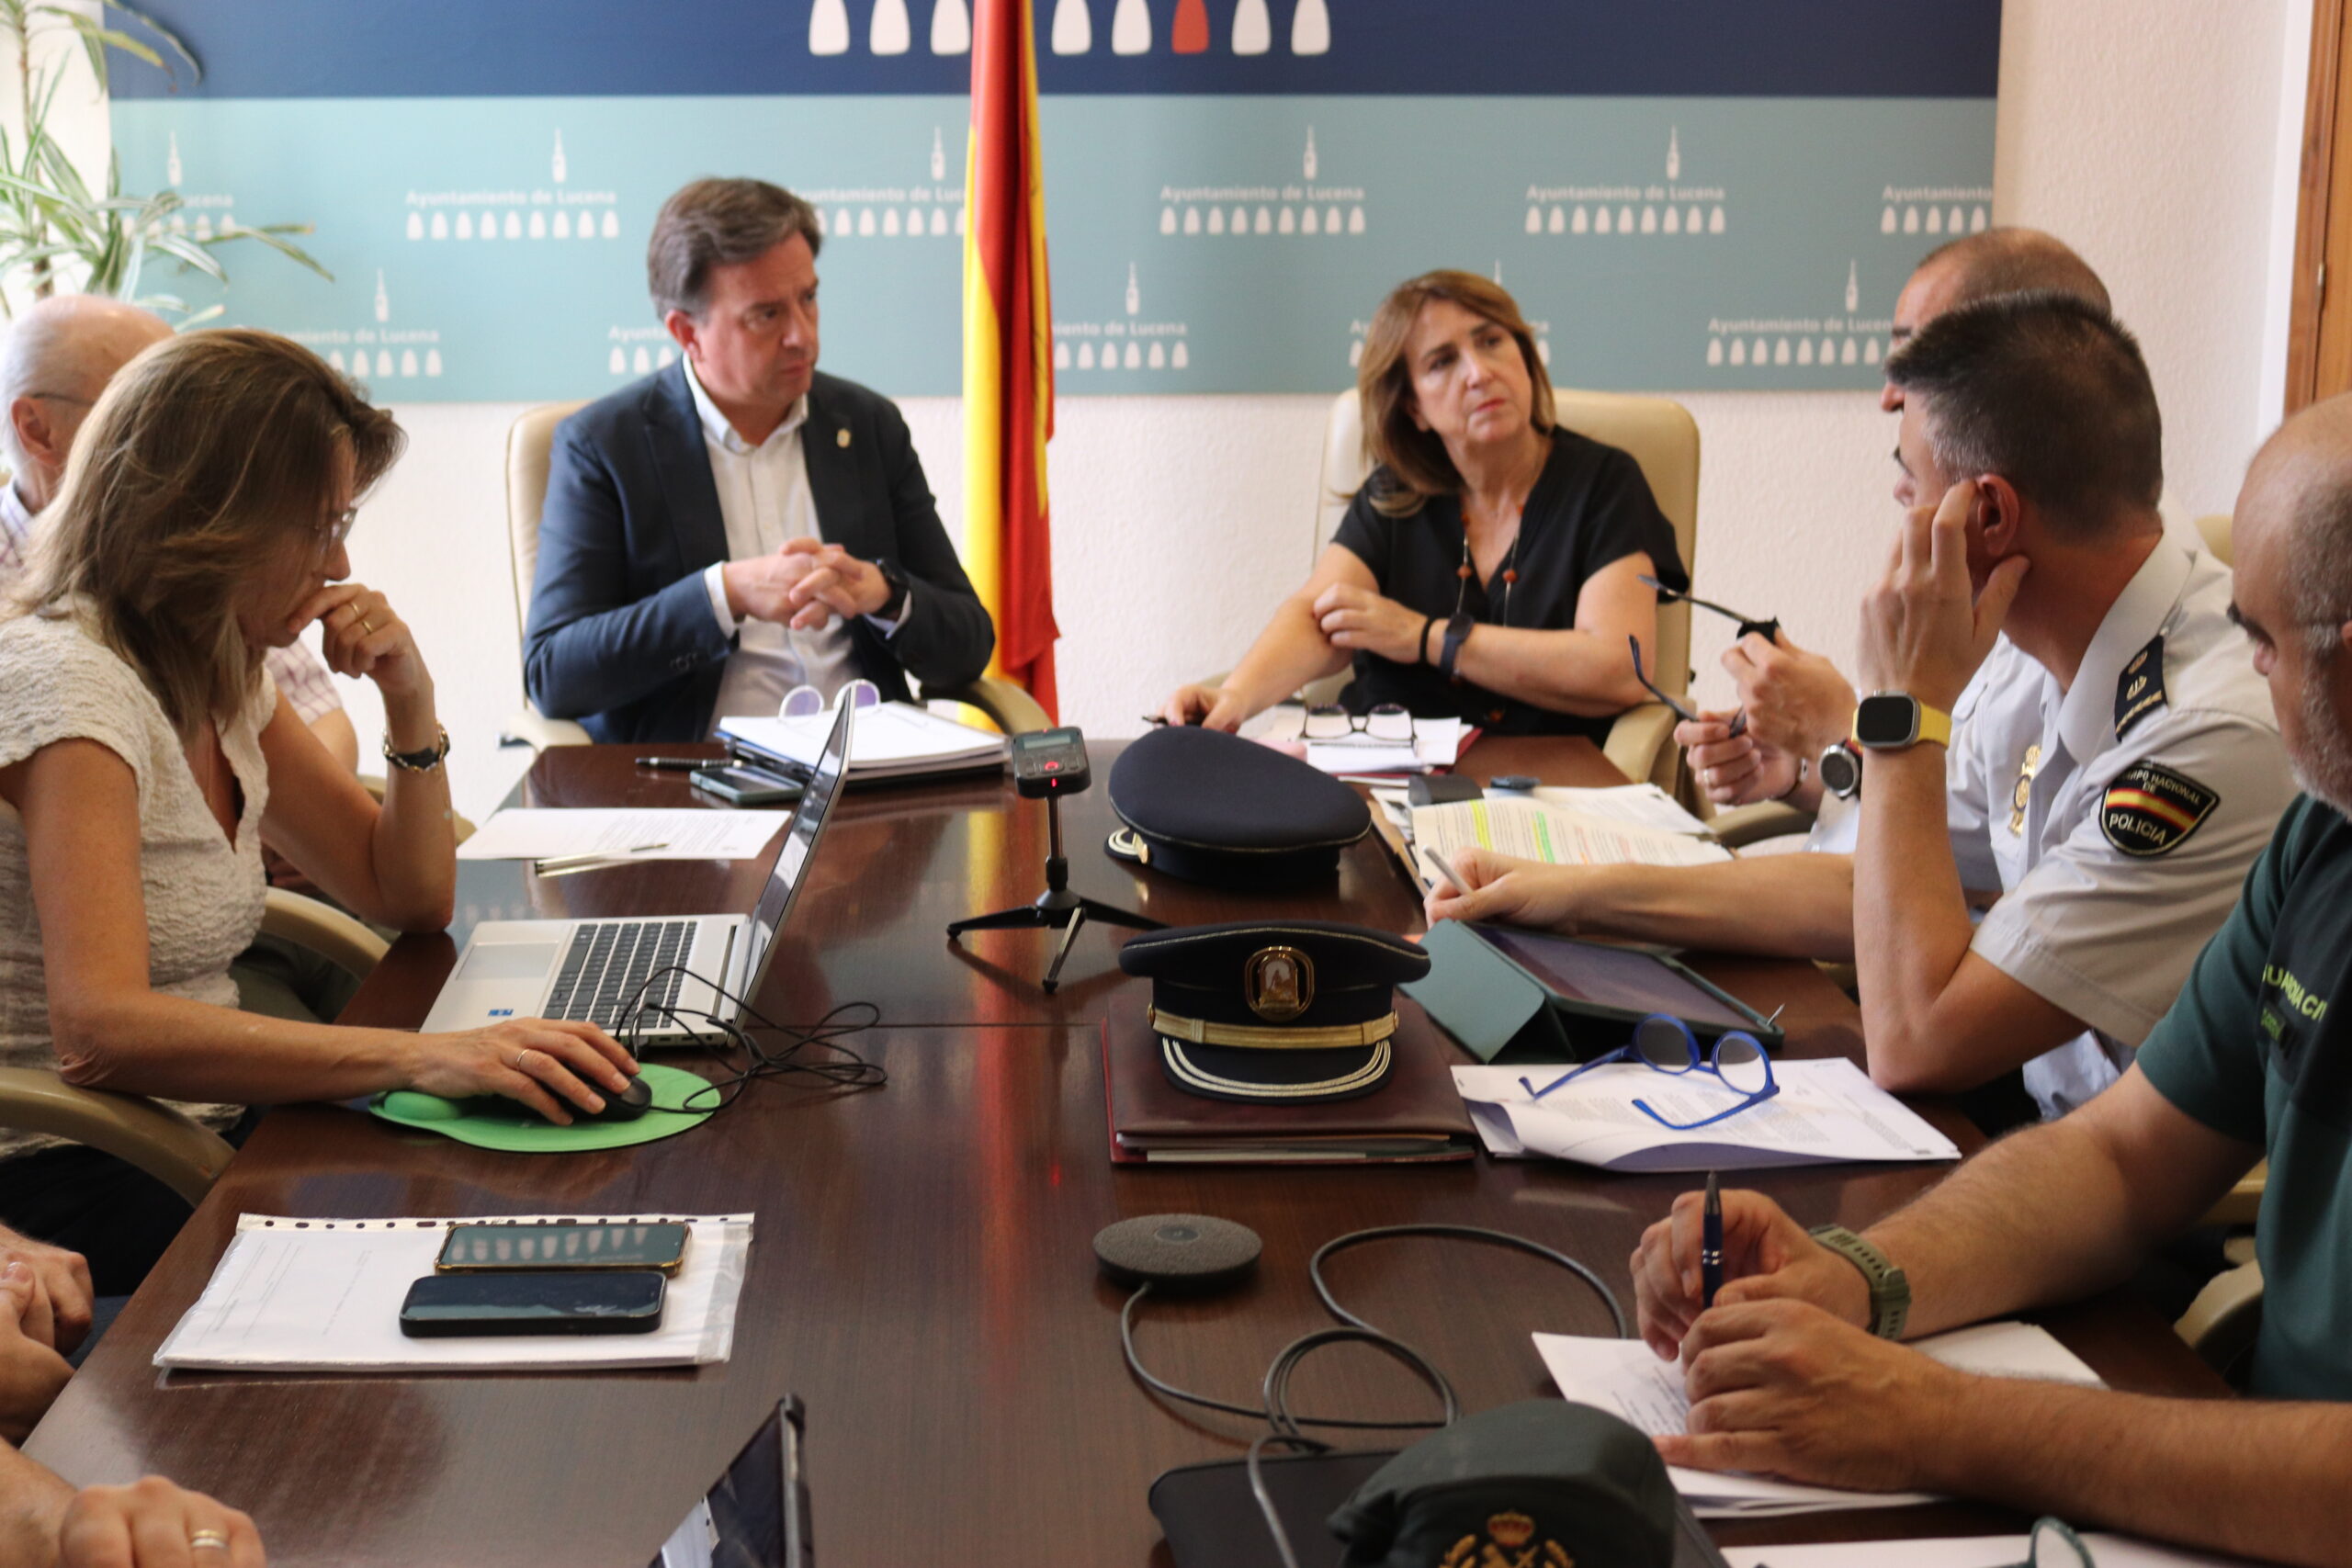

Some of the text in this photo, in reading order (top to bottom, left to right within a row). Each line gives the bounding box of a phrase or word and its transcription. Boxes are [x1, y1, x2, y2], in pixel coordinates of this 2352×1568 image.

[406, 189, 616, 208] Ayuntamiento de Lucena
[910, 186, 931, 201] de
[1160, 186, 1365, 203] Ayuntamiento de Lucena
[1525, 185, 1725, 203] Ayuntamiento de Lucena
[608, 325, 670, 343] Ayunta
[1104, 320, 1125, 335] de
[1129, 321, 1189, 335] Lucena
[1708, 318, 1893, 335] Ayuntamiento de Lucen
[354, 328, 376, 344] de
[380, 329, 440, 344] Lucena
[2142, 781, 2156, 795] DE
[2151, 773, 2200, 806] NACIONAL
[2109, 813, 2167, 845] POLICIA
[2262, 963, 2306, 1010] UARDIA
